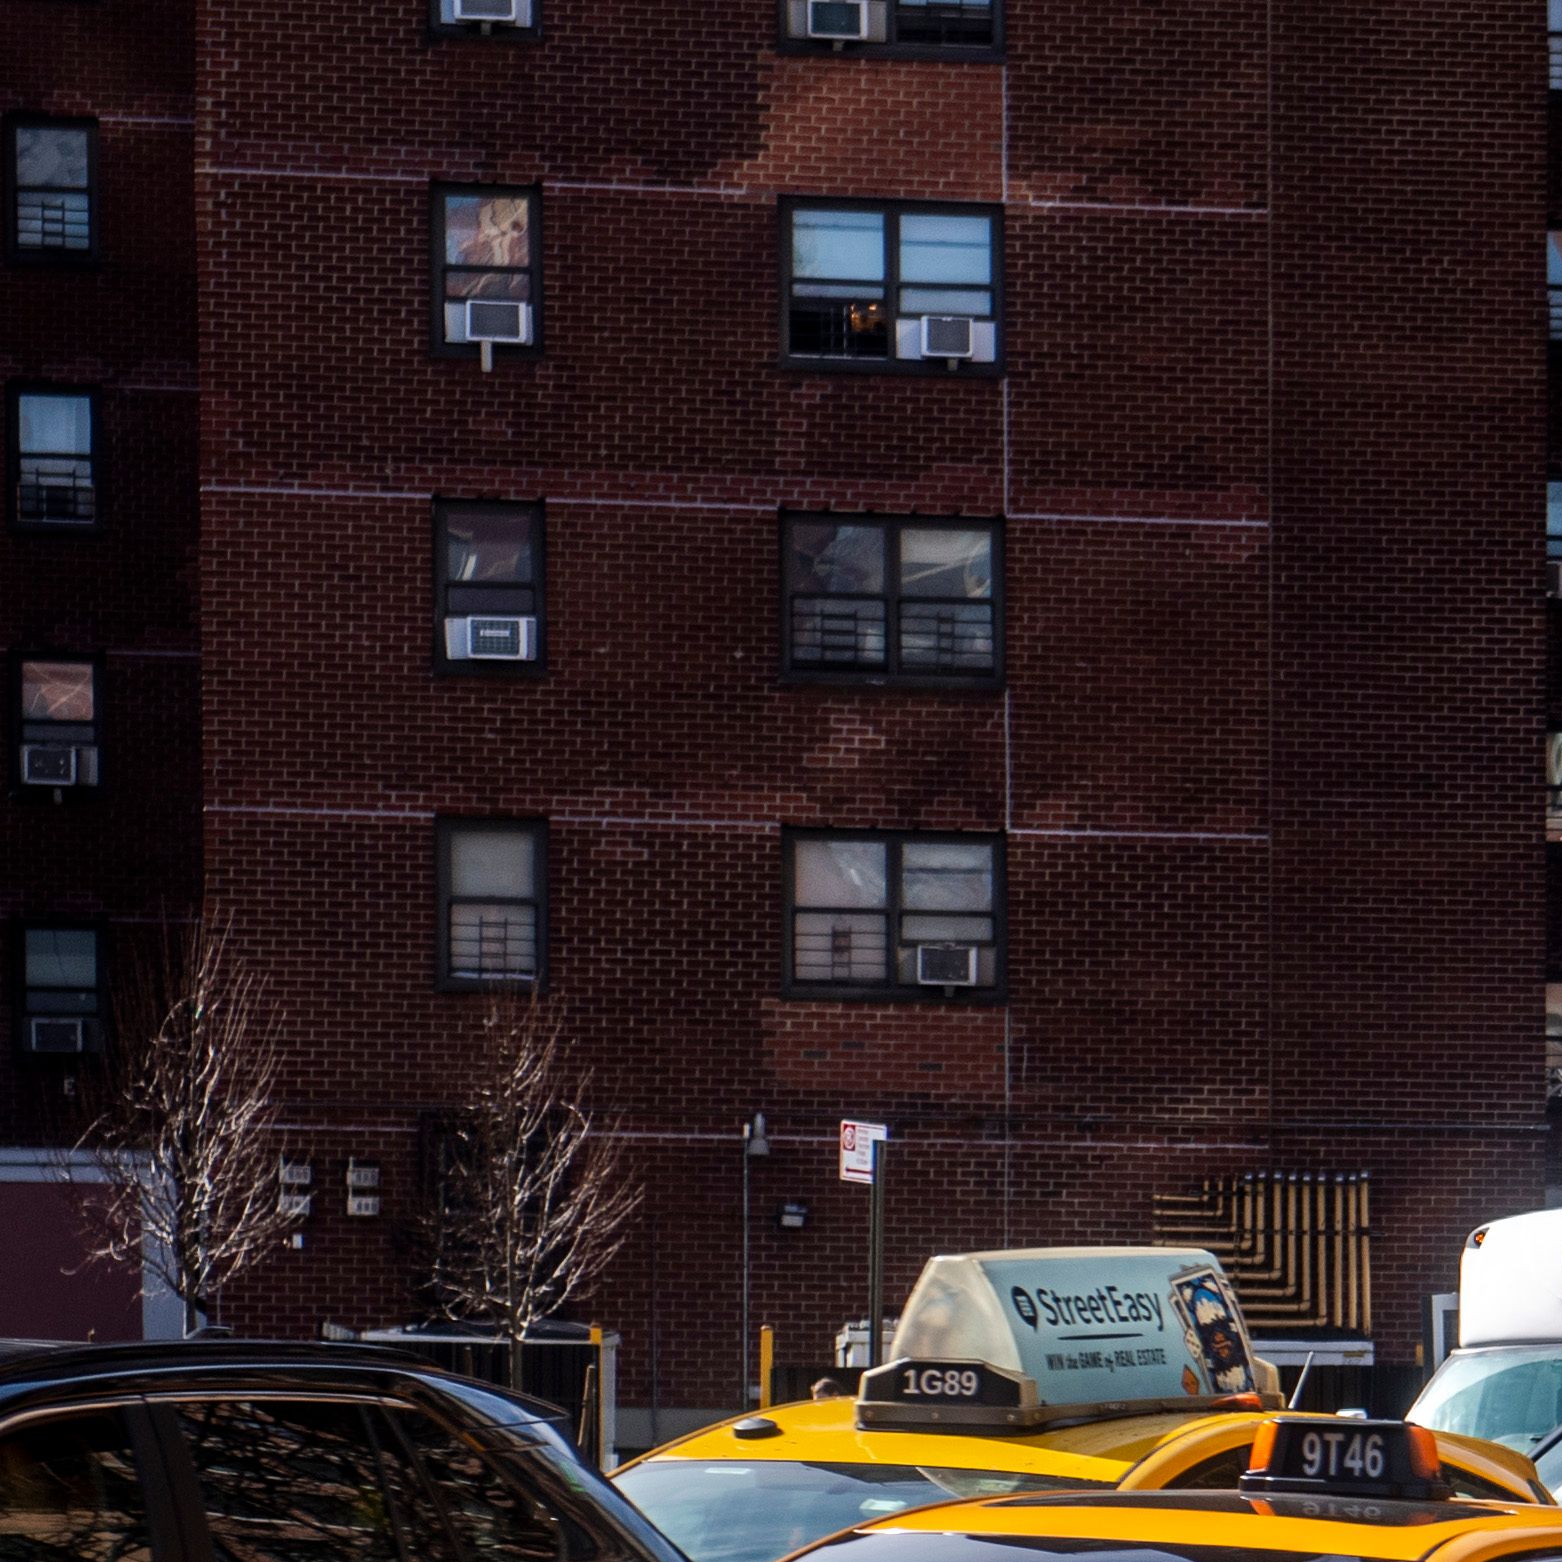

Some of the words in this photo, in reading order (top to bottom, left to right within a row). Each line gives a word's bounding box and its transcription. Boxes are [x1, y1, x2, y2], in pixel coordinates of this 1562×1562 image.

[1036, 1285, 1164, 1332] StreetEasy
[903, 1369, 978, 1396] 1G89
[1302, 1432, 1384, 1478] 9T46
